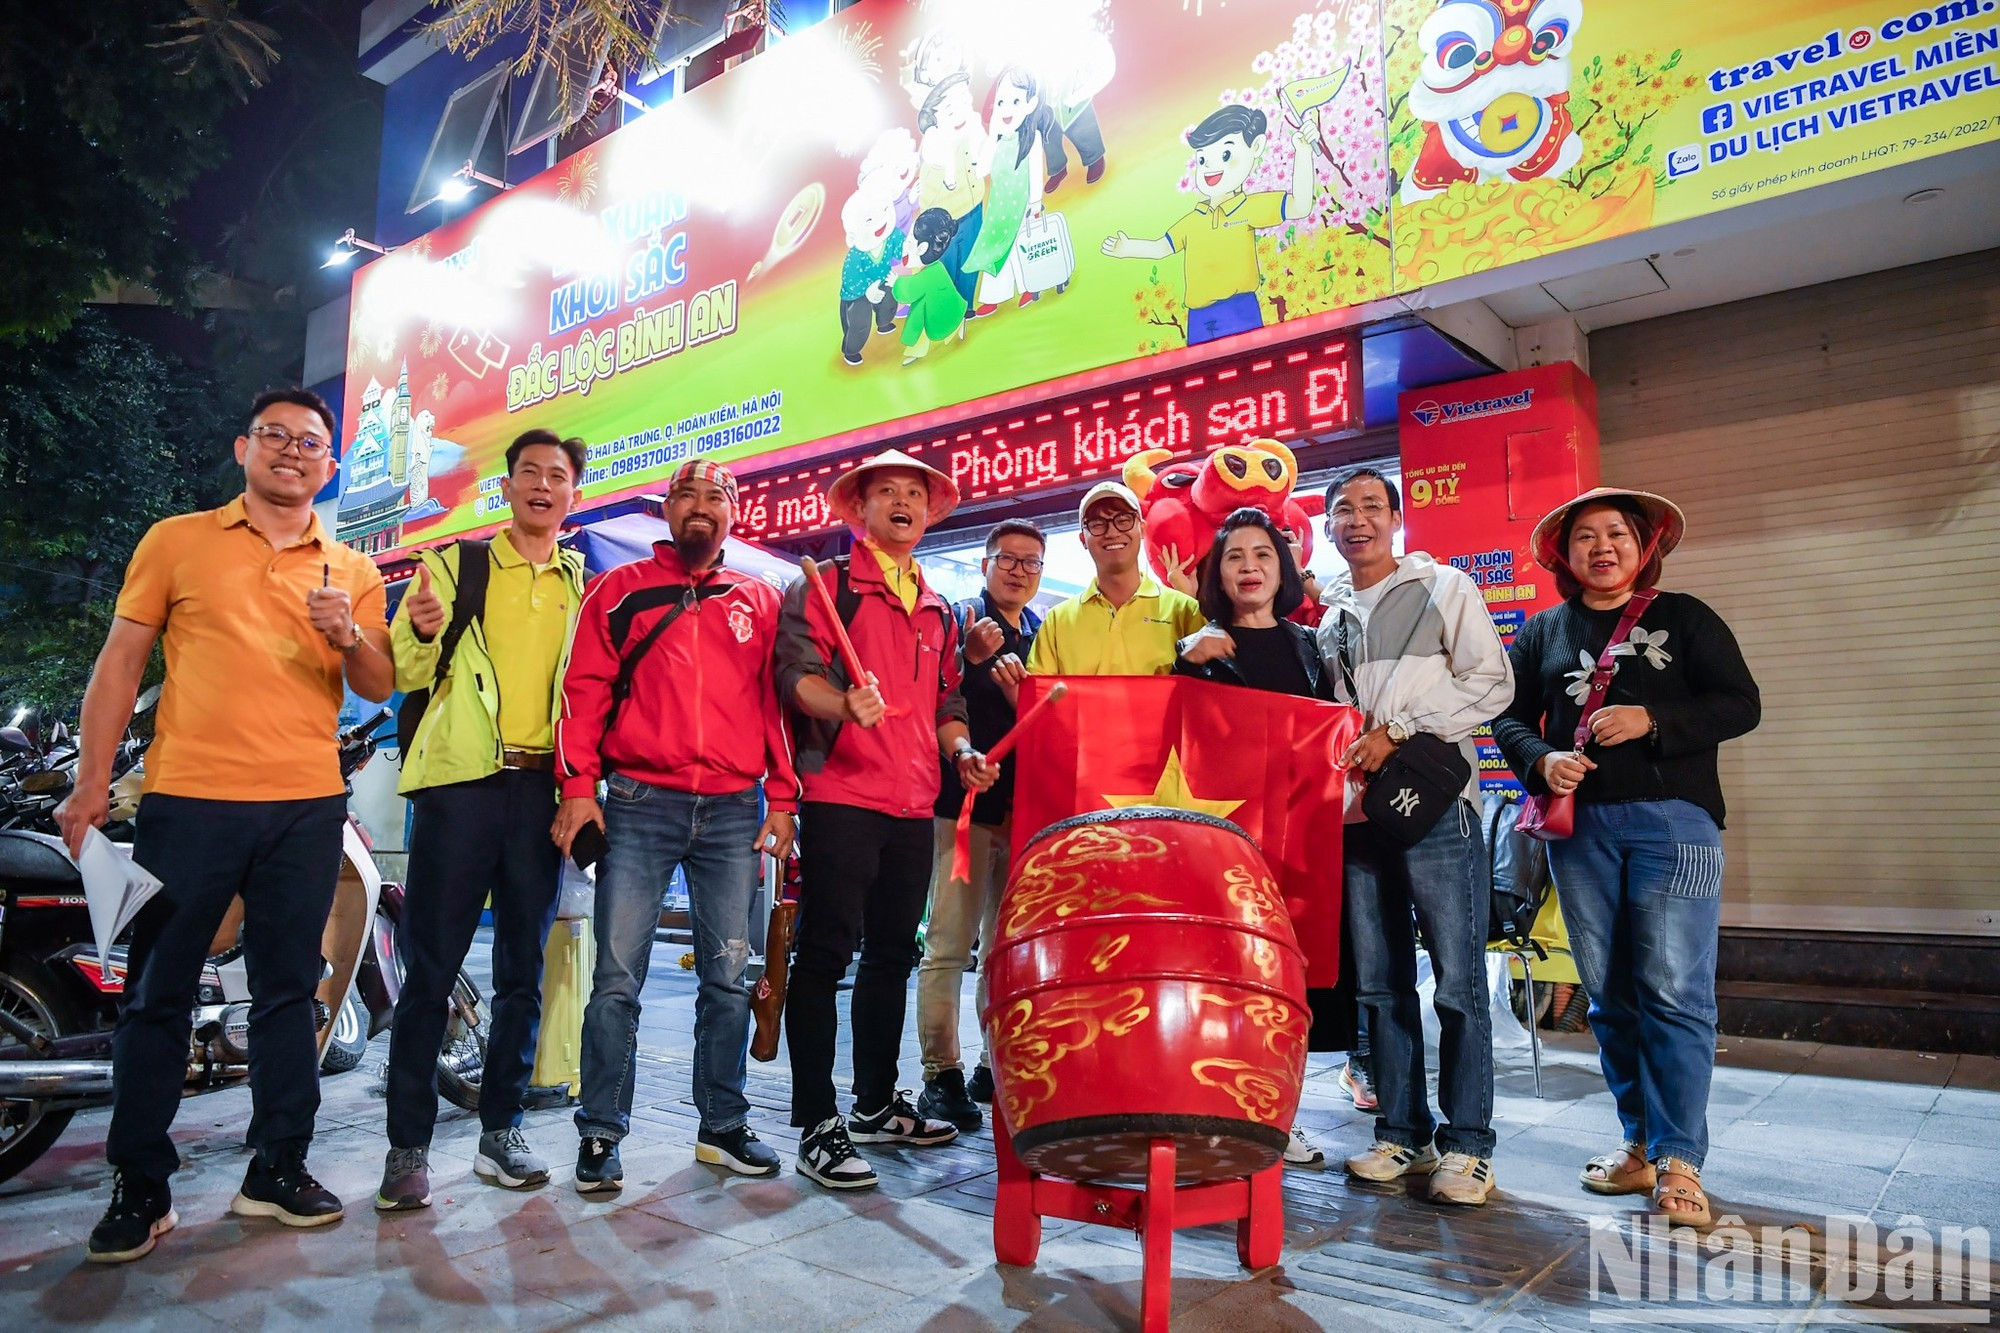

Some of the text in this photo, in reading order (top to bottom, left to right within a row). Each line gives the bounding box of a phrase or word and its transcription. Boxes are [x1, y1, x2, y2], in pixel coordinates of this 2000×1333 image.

[1708, 31, 1842, 92] travel
[1743, 28, 1998, 119] VIETRAVEL MIỀN
[1710, 66, 2000, 163] DU LỊCH VIETRAVEL
[1676, 153, 1697, 165] Zalo
[1712, 187, 1726, 200] Số
[1729, 181, 1754, 198] giấy
[1757, 173, 1788, 190] phép
[1790, 164, 1815, 180] kinh
[1818, 155, 1858, 173] doanh
[1861, 143, 1898, 161] LHQT:
[1027, 245, 1058, 261] GREEN
[507, 280, 737, 410] ĐẮC LỘC BÌNH AN
[595, 443, 611, 459] HAI
[613, 436, 626, 454] BÀ
[677, 414, 707, 434] HOÀN
[742, 398, 759, 416] HÀ
[761, 391, 782, 411] NỘI
[1442, 389, 1531, 418] Vietravel
[611, 441, 687, 477] 0989370033
[697, 415, 781, 454] 0983160022
[951, 439, 1057, 488] Phòng
[1074, 400, 1190, 465] khách
[777, 483, 831, 527] máy
[1410, 479, 1433, 509] 9
[1450, 549, 1513, 570] DU XUÂN
[1486, 565, 1514, 583] SẮC
[1484, 586, 1515, 603] BÌNH
[1516, 584, 1536, 600] AN
